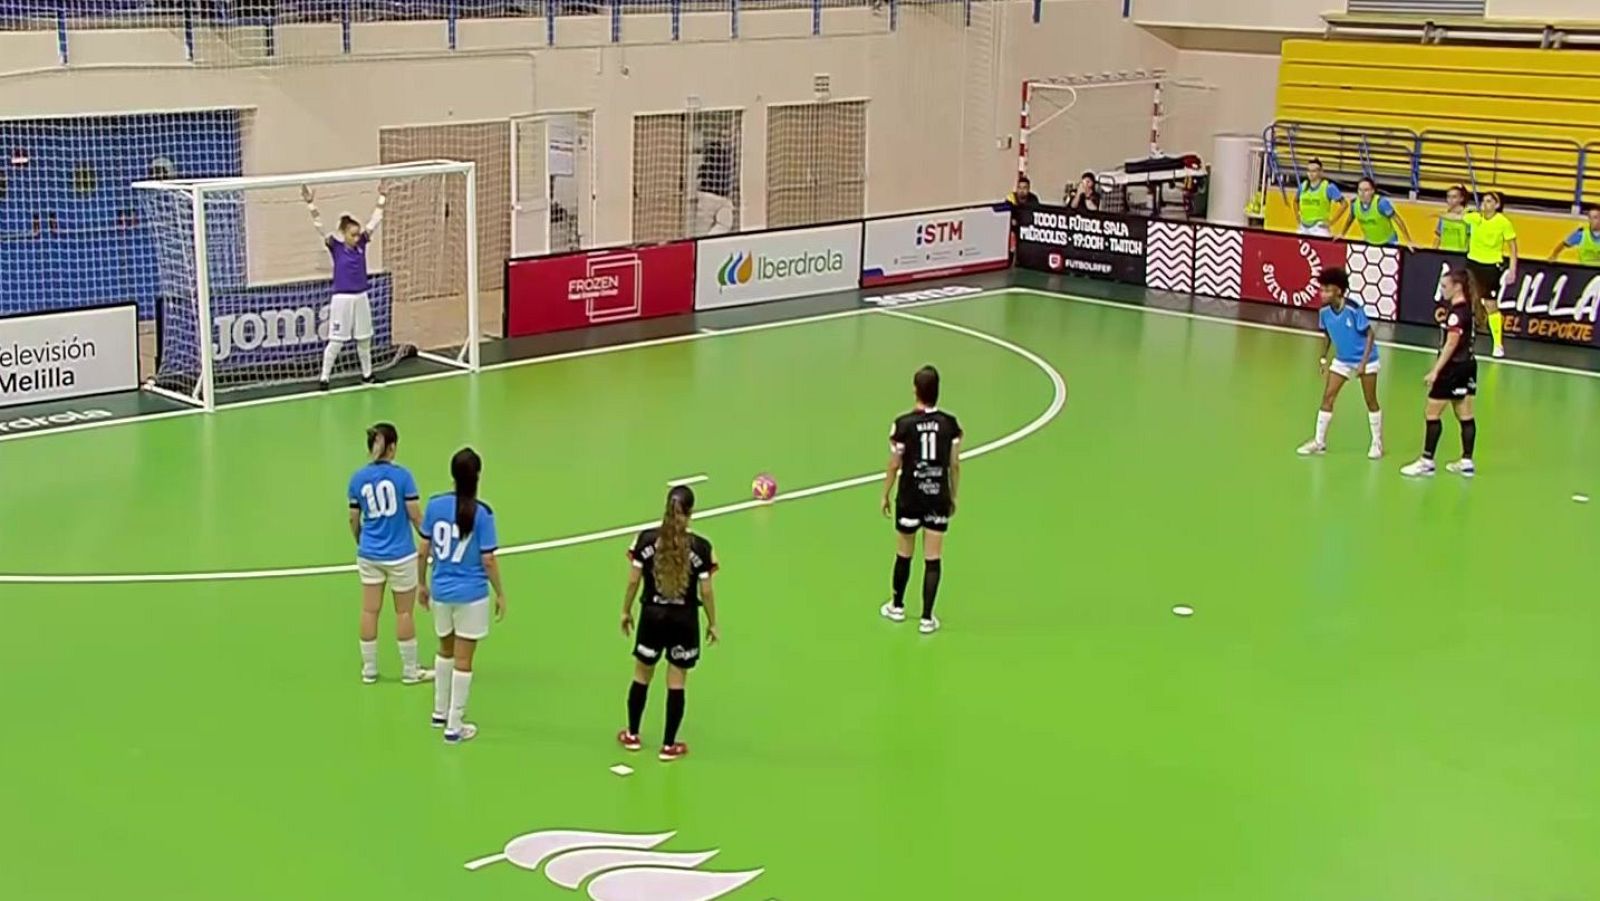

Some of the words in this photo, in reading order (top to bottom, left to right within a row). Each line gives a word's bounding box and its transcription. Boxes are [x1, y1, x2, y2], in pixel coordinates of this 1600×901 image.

[924, 221, 964, 244] STM
[1032, 212, 1057, 227] TODO
[1058, 215, 1068, 229] EL
[1068, 215, 1102, 234] FÚTBOL
[1103, 221, 1129, 237] SALA
[1019, 225, 1068, 245] MIÉRCOLES
[1073, 233, 1105, 250] 19:00H
[1110, 237, 1143, 254] TWITCH
[758, 250, 844, 280] Iberdrola
[568, 275, 619, 293] FROZEN
[1262, 263, 1288, 305] SUELA
[1527, 318, 1594, 341] DEPORTE
[0, 336, 96, 368] elevisión
[921, 432, 937, 460] 11
[361, 479, 398, 518] 10
[433, 520, 473, 563] 97
